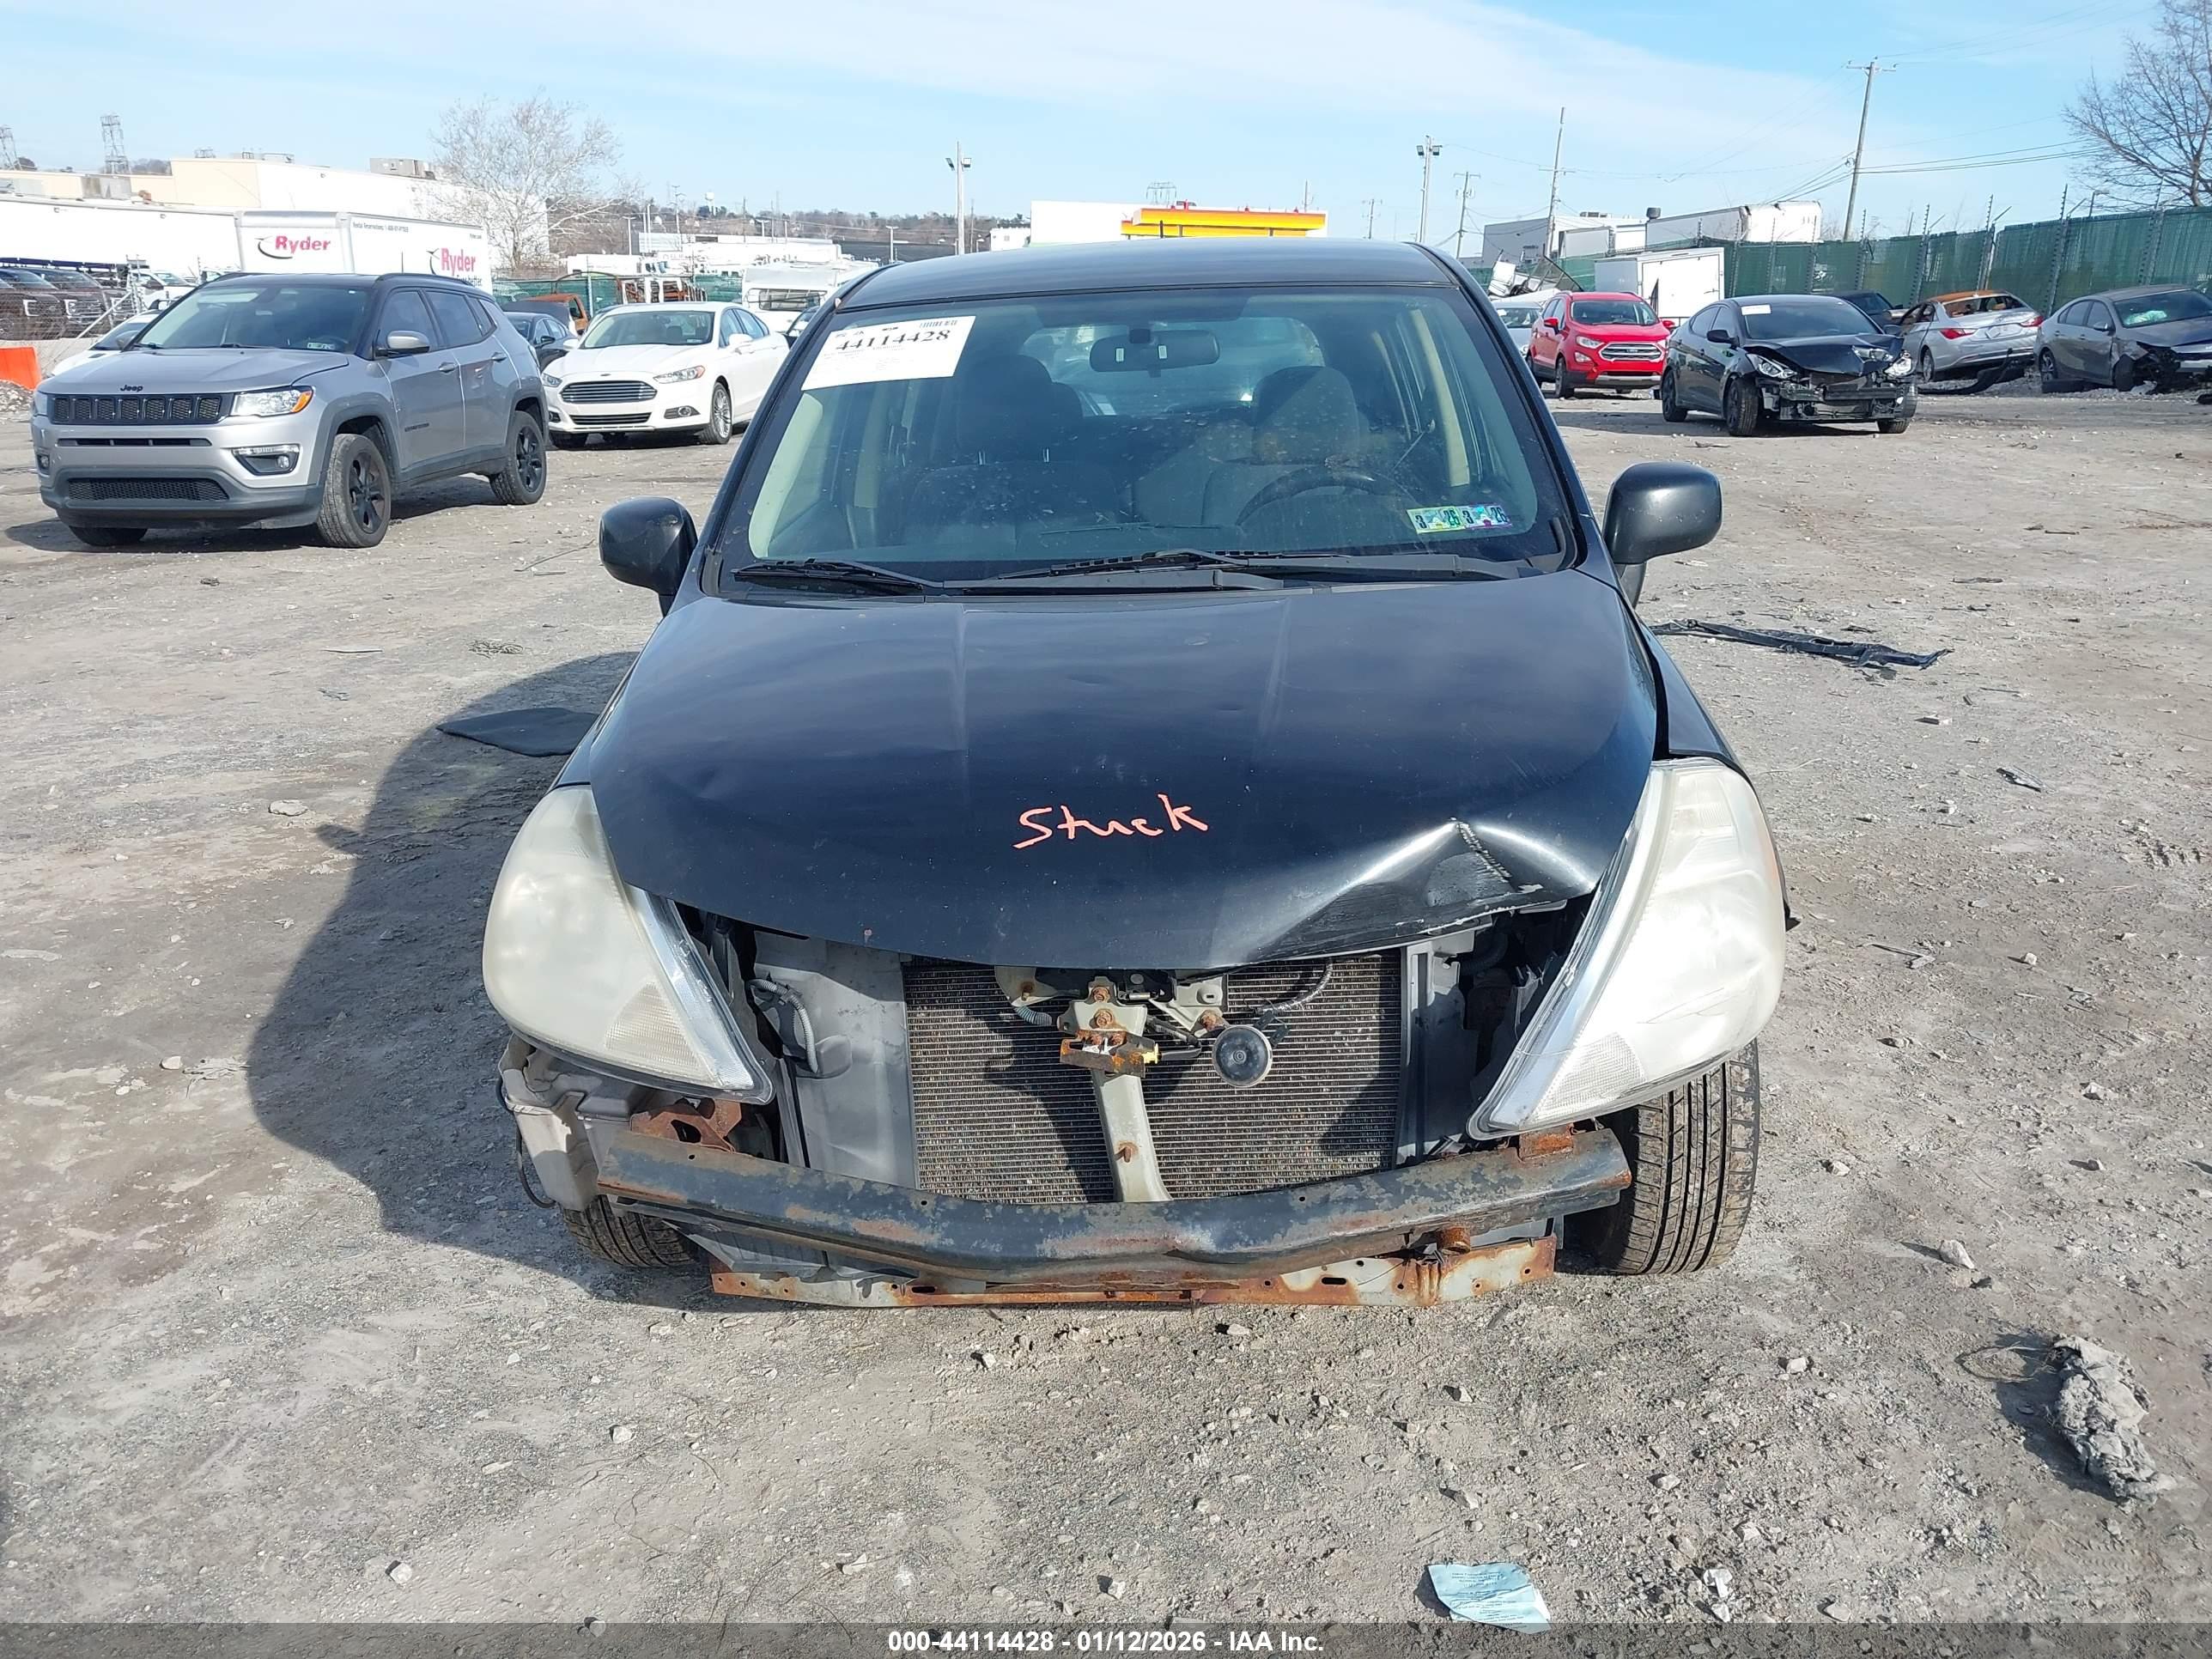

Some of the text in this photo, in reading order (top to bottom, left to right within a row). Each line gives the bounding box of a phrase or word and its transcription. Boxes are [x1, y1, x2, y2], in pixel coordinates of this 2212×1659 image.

[275, 235, 331, 254] Ryder
[441, 247, 476, 276] Ryder
[836, 329, 951, 350] 44114428
[120, 384, 143, 392] Jeep
[1415, 514, 1427, 529] 3
[1462, 507, 1509, 525] 3 26
[1012, 793, 1209, 849] Stuck
